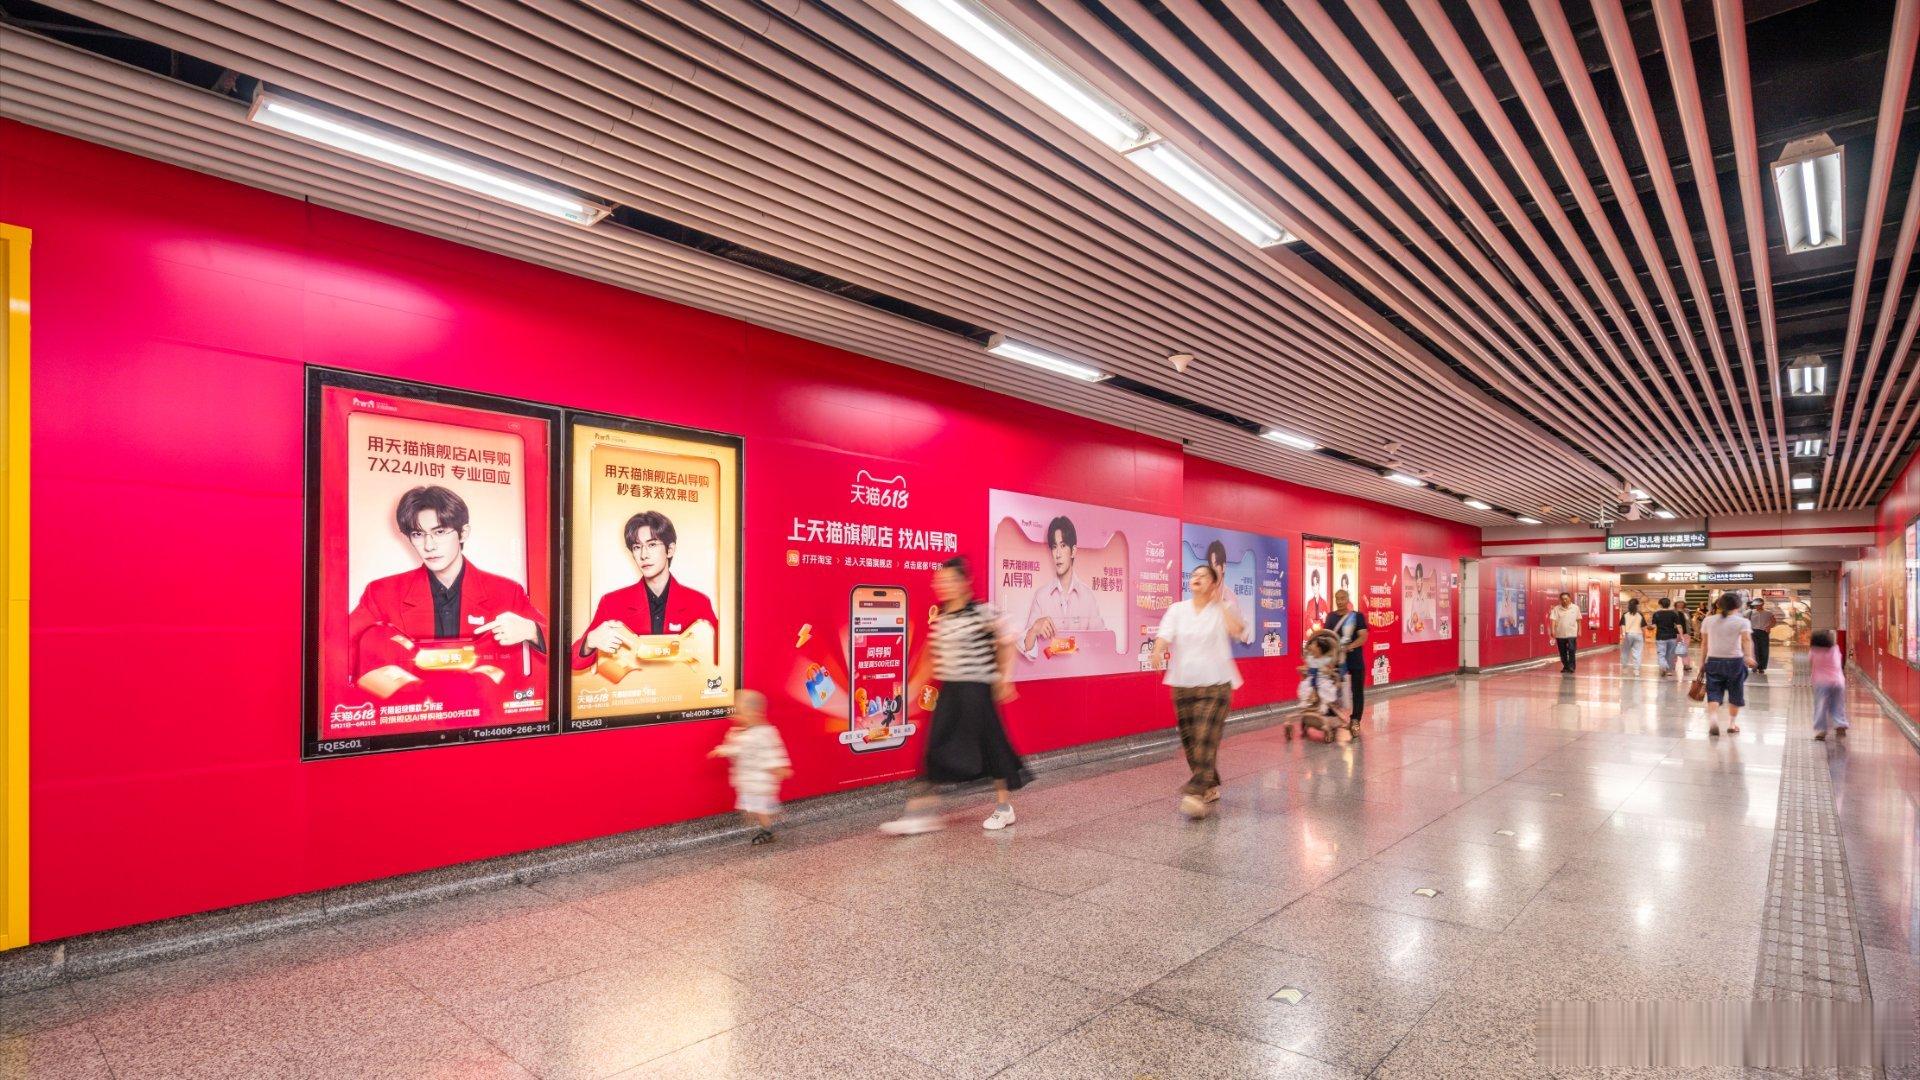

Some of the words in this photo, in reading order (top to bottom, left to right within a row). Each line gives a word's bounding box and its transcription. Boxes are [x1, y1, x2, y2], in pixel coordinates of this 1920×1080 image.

[368, 436, 510, 467] 用天猫旗舰店AI导购
[368, 457, 445, 479] 7X24小时
[451, 465, 511, 485] 专业回应
[605, 464, 709, 488] 用天猫旗舰店AI导购
[617, 482, 699, 502] 秒看家装效果图
[850, 484, 909, 509] 天猫618
[787, 517, 893, 548] 上天猫旗舰店
[898, 527, 958, 553] 找AI导购
[802, 553, 832, 565] 打开淘宝
[844, 556, 893, 569] 进入天猫旗舰店
[1003, 572, 1033, 588] AI导购
[331, 709, 376, 722] 天猫618
[318, 740, 362, 752] FQESc01
